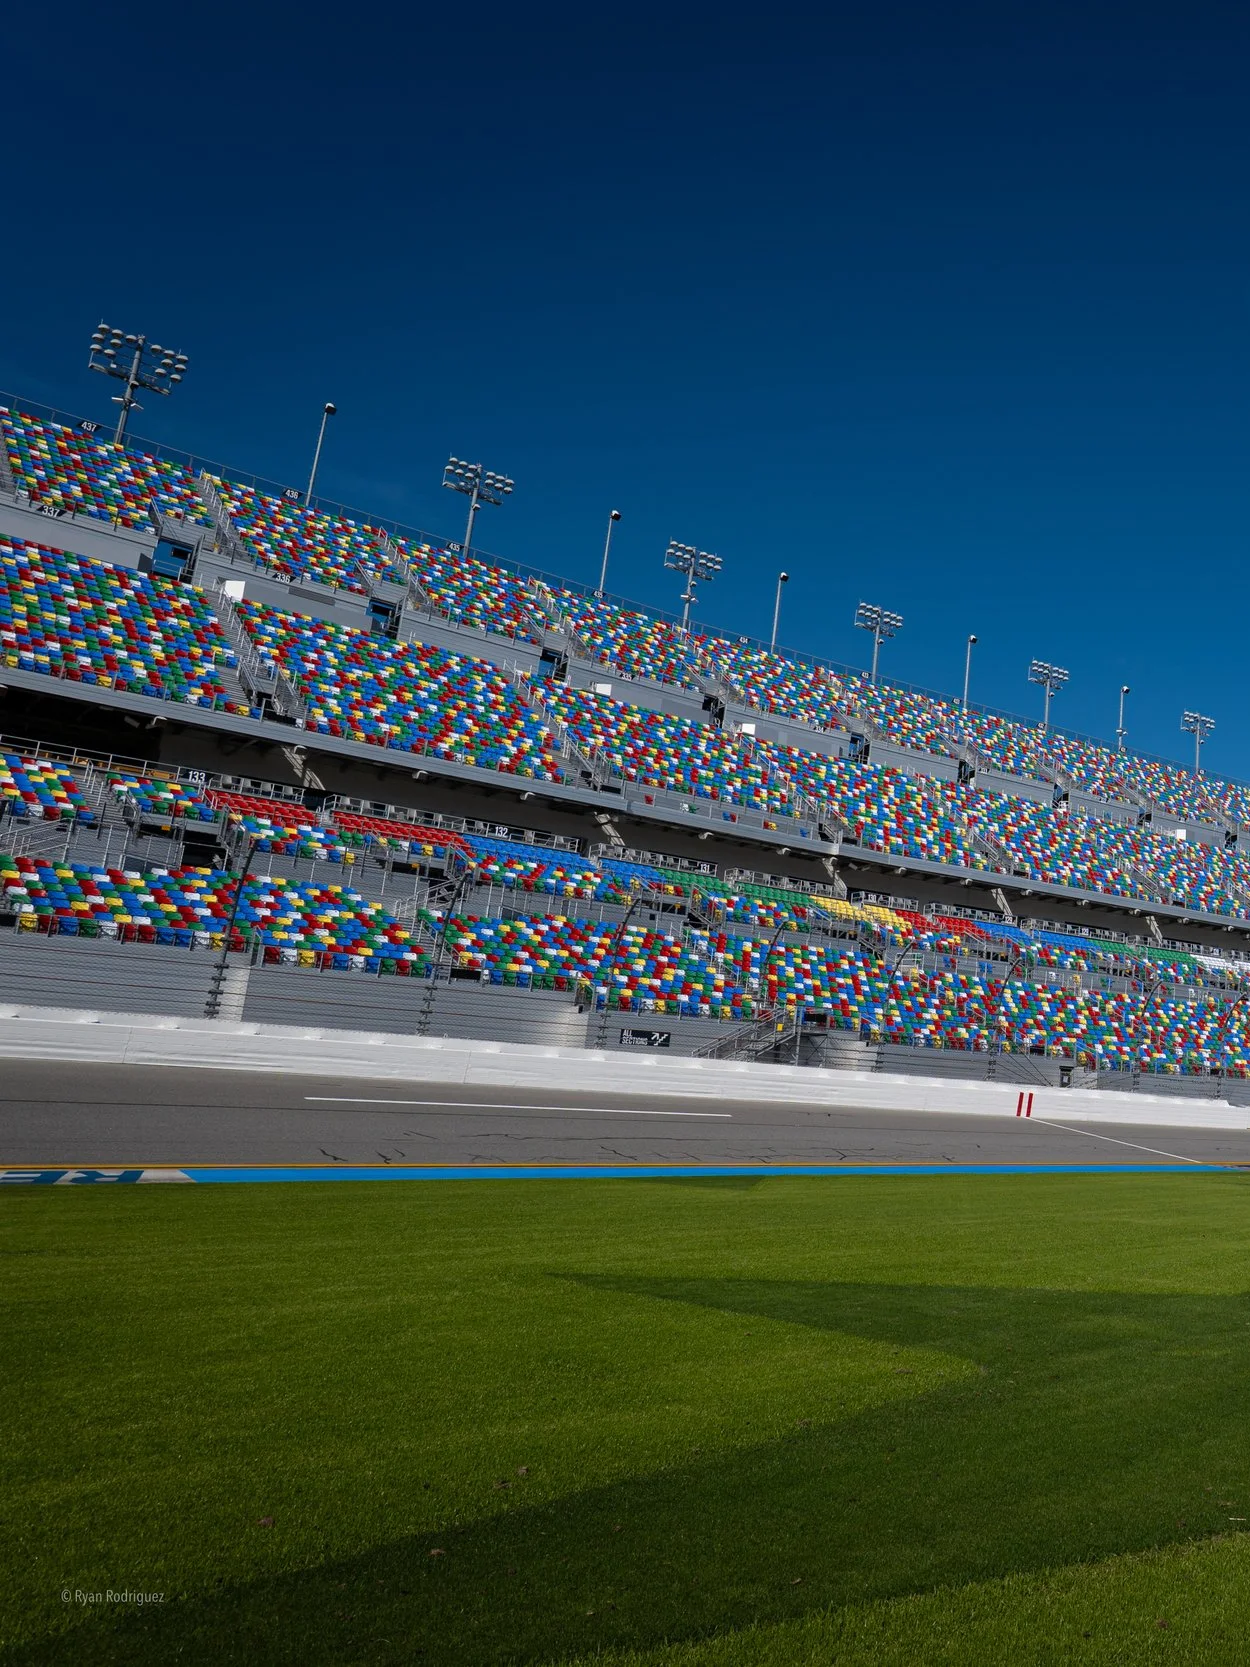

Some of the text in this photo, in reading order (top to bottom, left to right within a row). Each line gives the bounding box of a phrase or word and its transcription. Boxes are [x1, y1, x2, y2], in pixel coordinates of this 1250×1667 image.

[81, 421, 97, 432] 437
[285, 489, 298, 499] 436
[42, 505, 59, 517] 337
[449, 542, 461, 552] 435
[276, 572, 290, 584] 336
[622, 672, 632, 681] 335
[188, 770, 206, 783] 133
[495, 826, 508, 838] 132
[700, 864, 710, 874] 131
[868, 894, 877, 903] 130
[621, 1036, 648, 1045] SECTIONS
